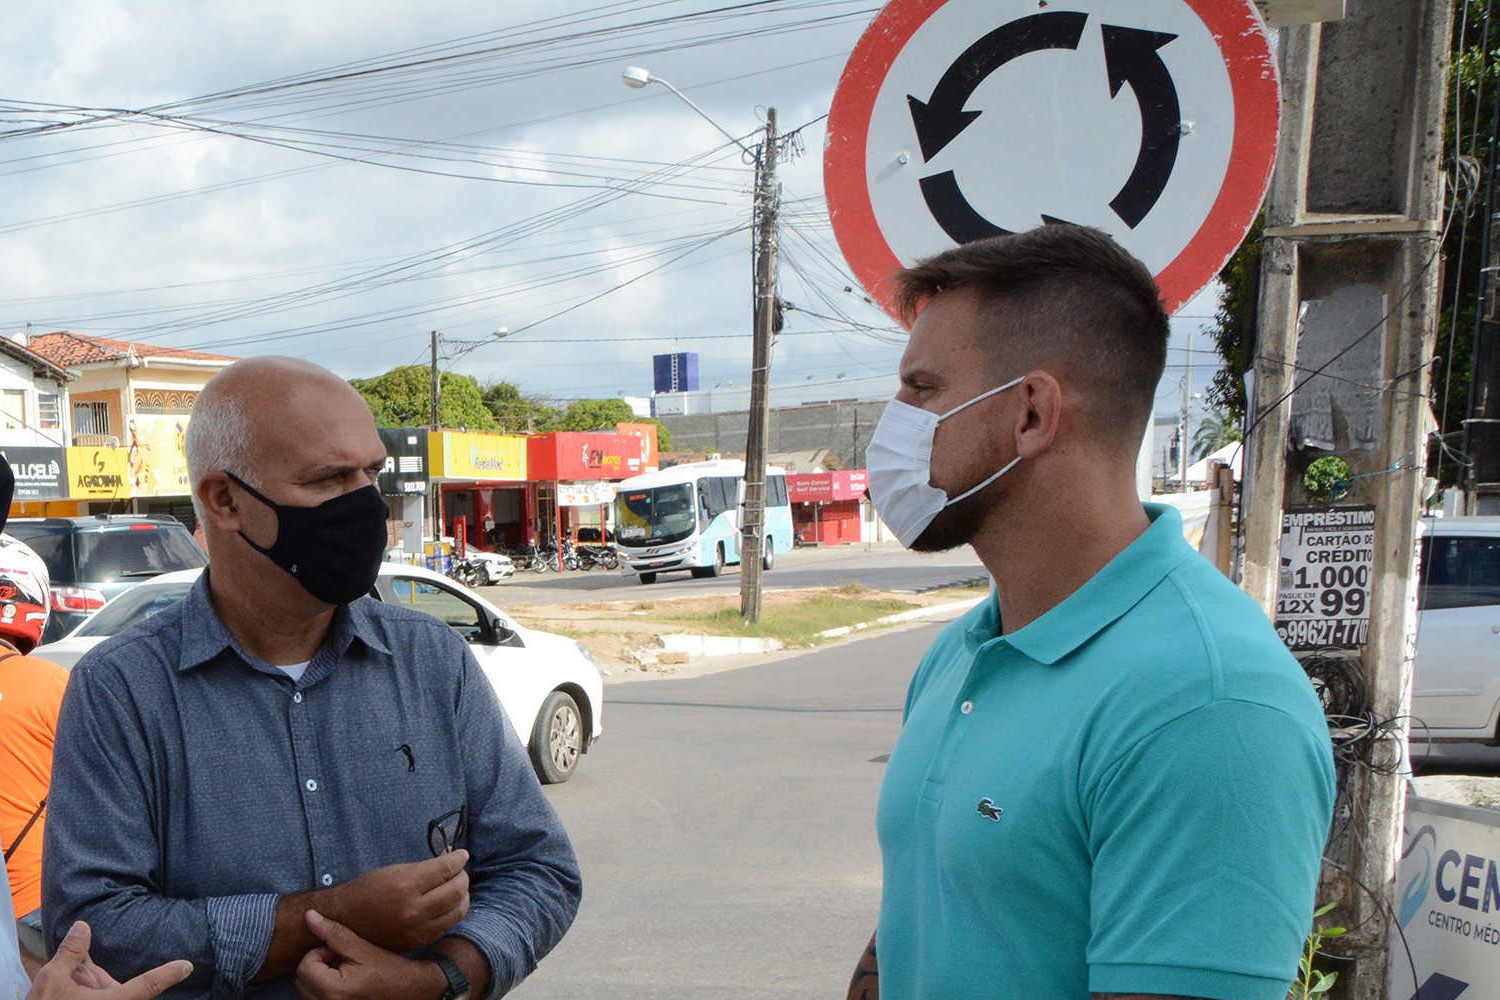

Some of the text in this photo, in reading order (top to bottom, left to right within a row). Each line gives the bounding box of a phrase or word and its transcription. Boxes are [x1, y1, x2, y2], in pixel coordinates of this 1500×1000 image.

[474, 457, 504, 470] RedeMed
[1283, 508, 1375, 527] EMPRÉSTIMO
[1306, 533, 1373, 547] CARTÃO DE
[1306, 546, 1373, 564] CRÉDITO
[1294, 565, 1368, 589] 1.000
[1278, 588, 1366, 616] 12X 99
[1287, 619, 1369, 646] 99627-7707
[1428, 910, 1471, 937] CENTRO
